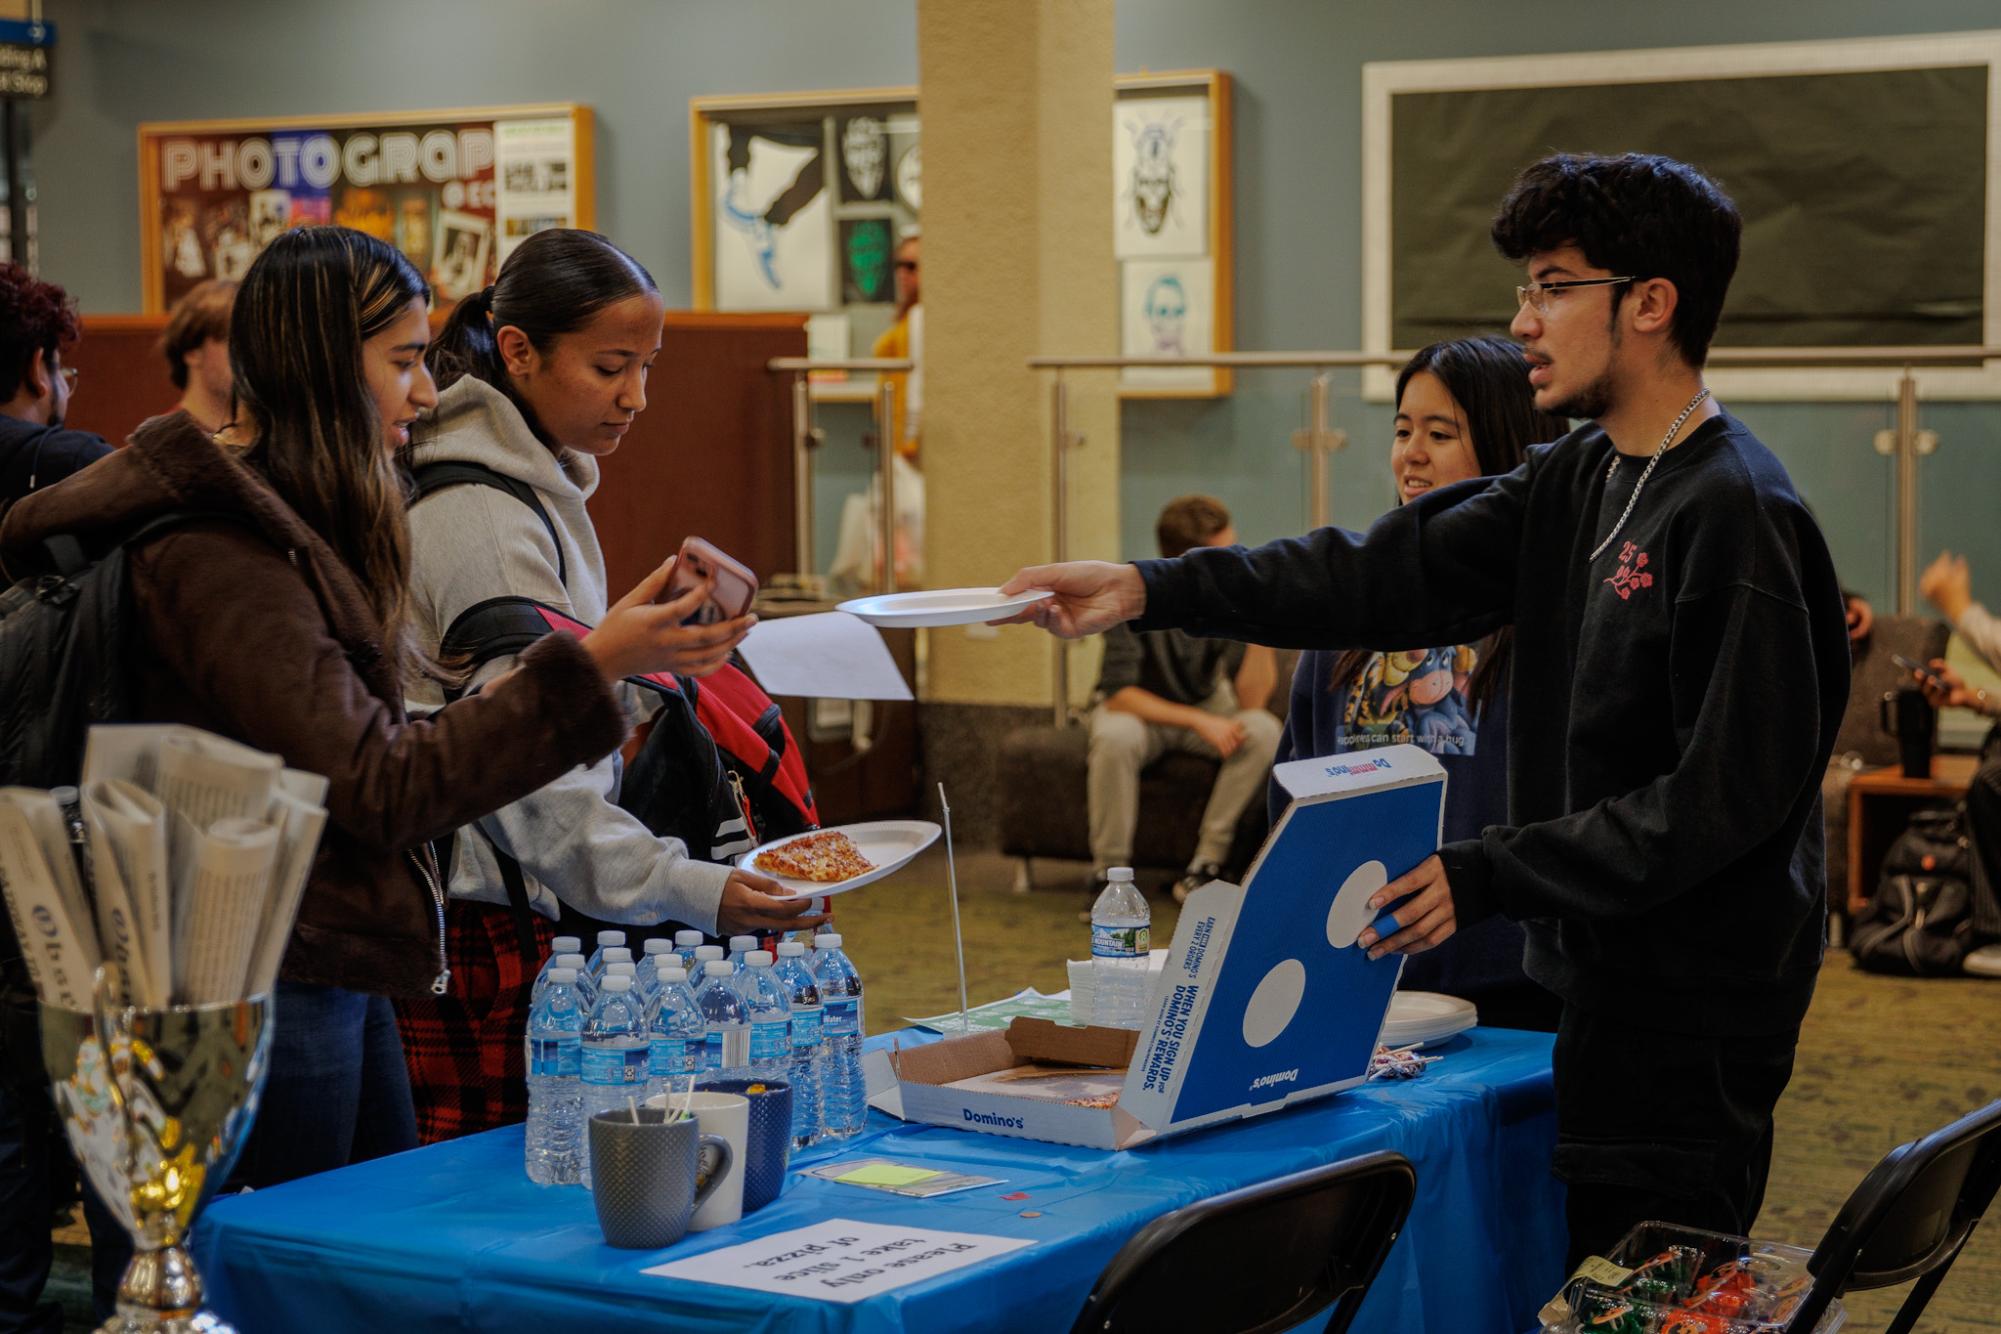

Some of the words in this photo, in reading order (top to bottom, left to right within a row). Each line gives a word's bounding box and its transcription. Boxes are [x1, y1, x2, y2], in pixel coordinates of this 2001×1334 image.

[161, 128, 494, 190] PHOTOGRAP
[1372, 734, 1389, 743] can
[1391, 734, 1415, 743] start
[1445, 734, 1465, 746] hug
[1180, 985, 1199, 1017] WHEN
[1172, 1018, 1188, 1039] YOU
[1163, 1040, 1180, 1065] SIGN
[1159, 1066, 1171, 1081] UP
[963, 1108, 1025, 1129] Domino's
[826, 1237, 860, 1246] of
[860, 1238, 926, 1256] take
[743, 1243, 832, 1269] pizza.
[884, 1242, 977, 1268] Please
[772, 1262, 840, 1281] slice
[820, 1268, 885, 1288] only
